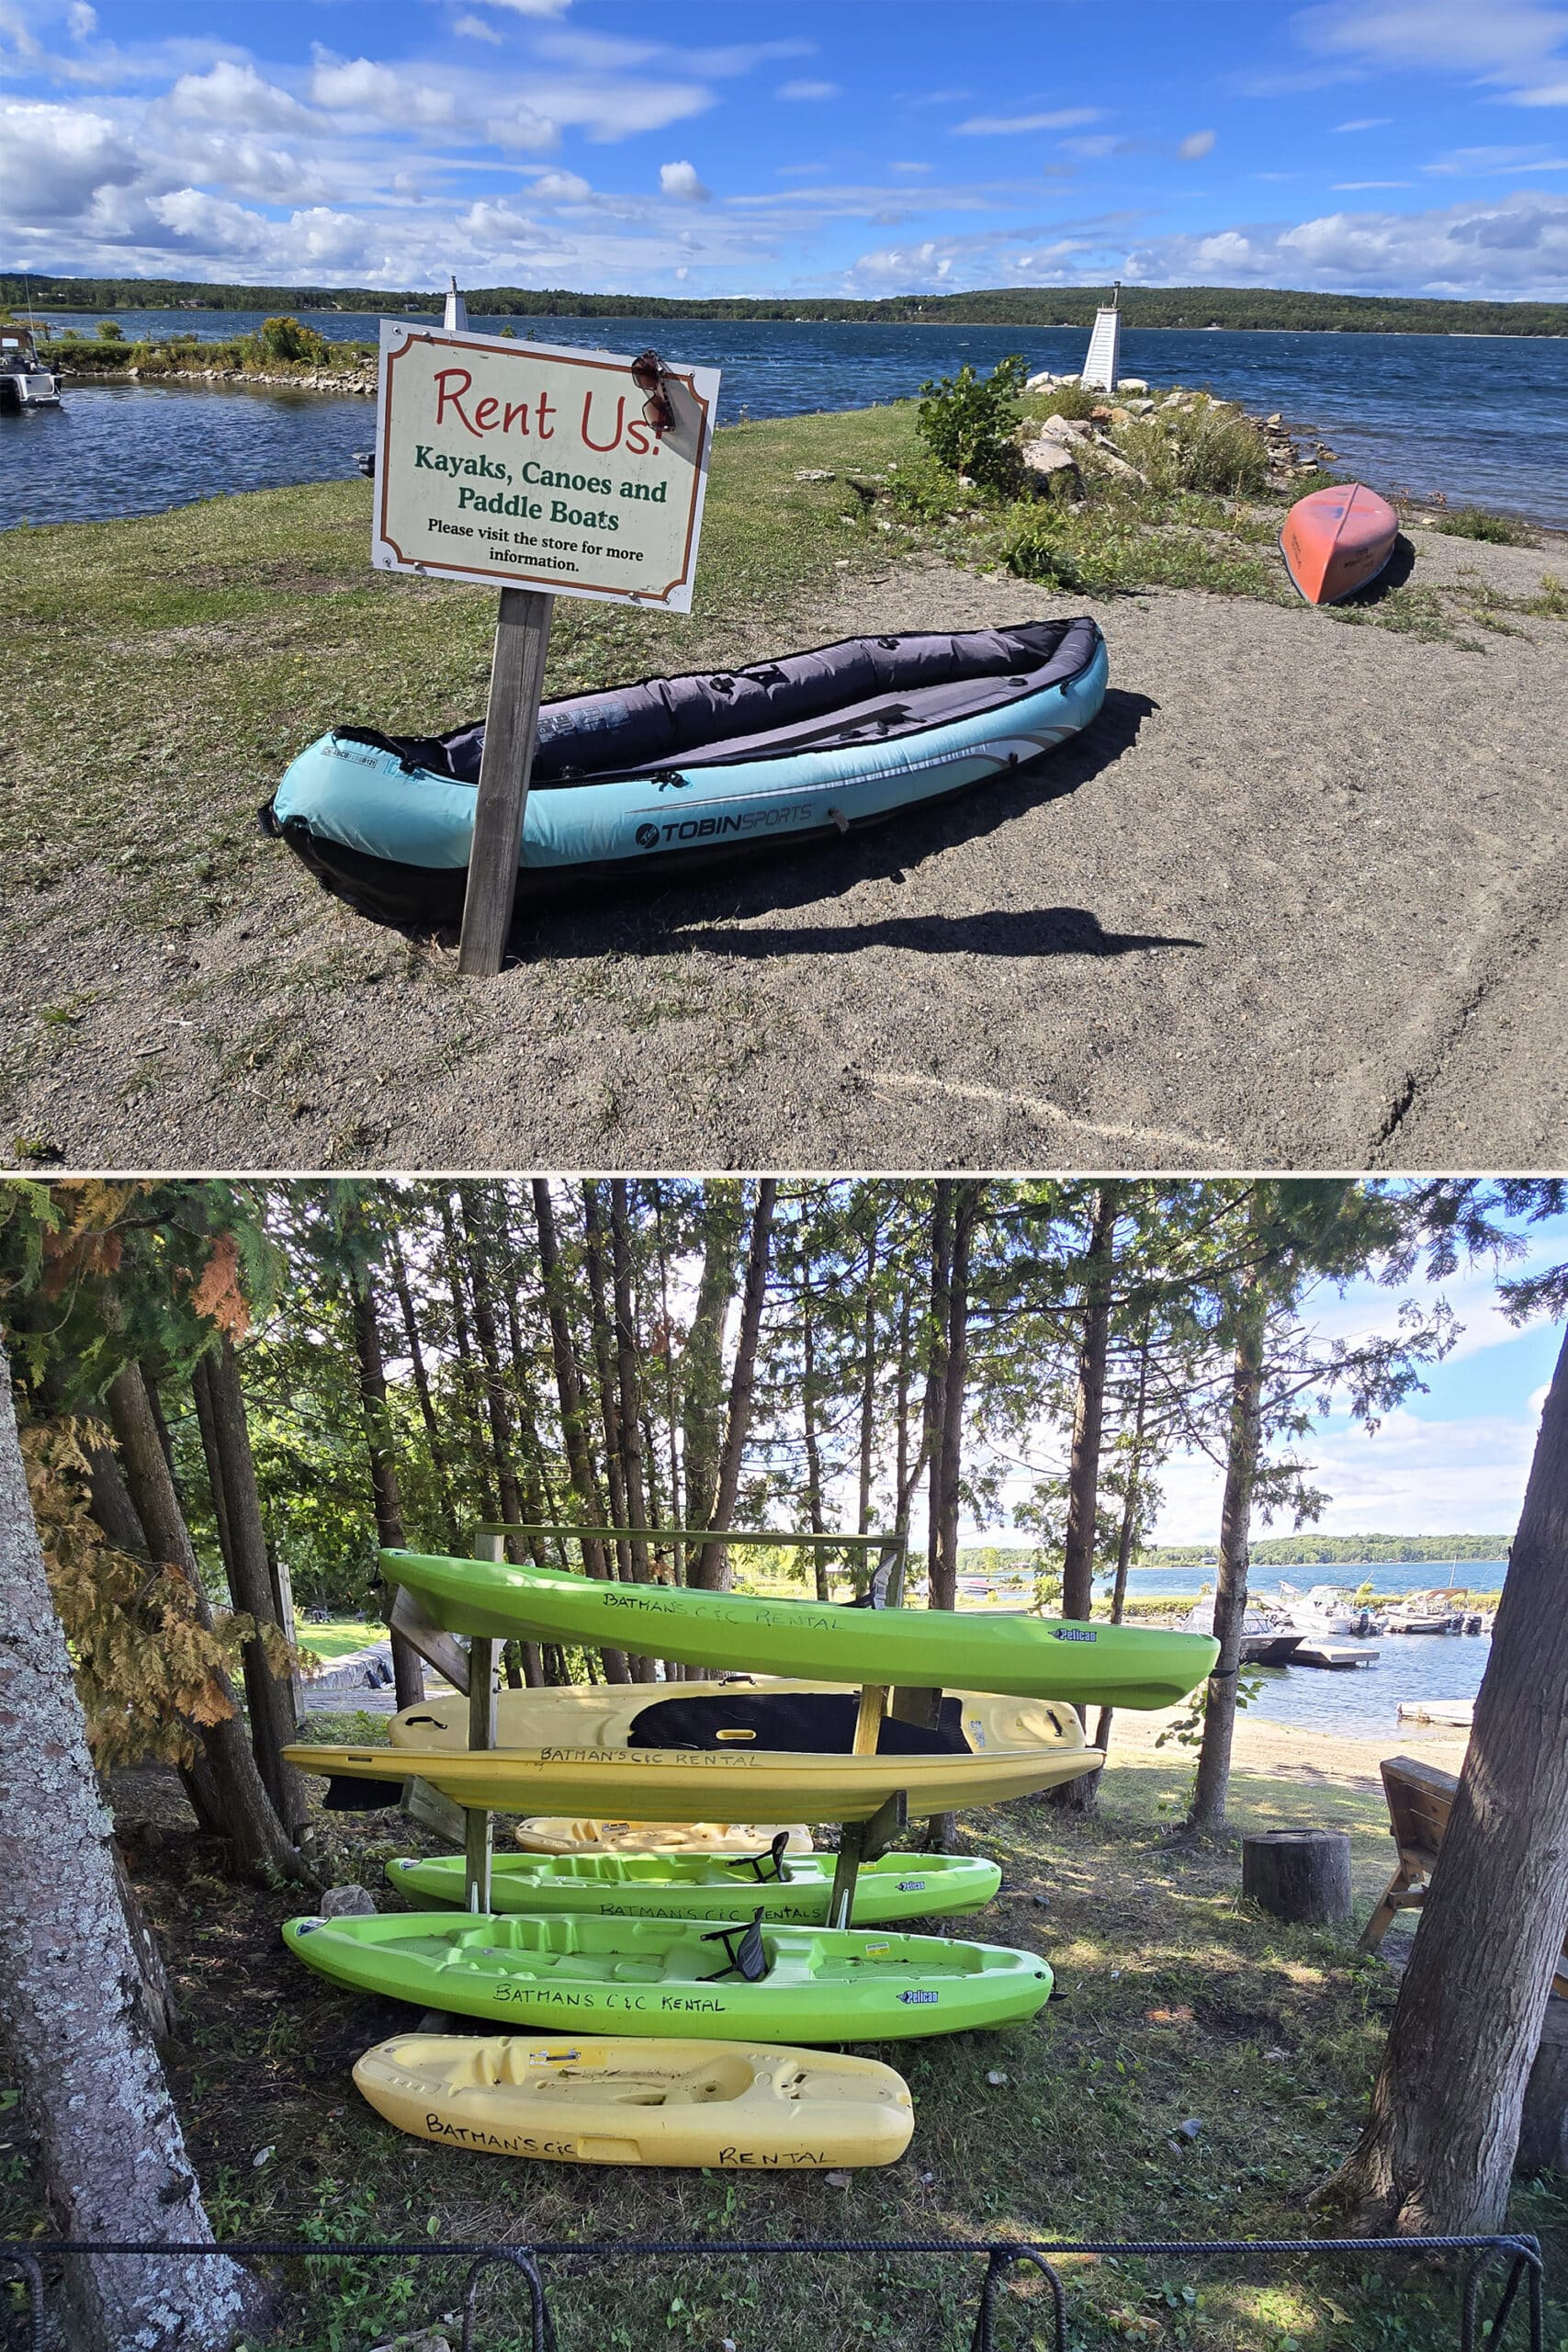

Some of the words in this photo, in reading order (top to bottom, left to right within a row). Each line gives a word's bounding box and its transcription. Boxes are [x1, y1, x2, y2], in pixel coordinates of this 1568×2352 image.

[433, 368, 557, 439] Rent
[414, 445, 513, 486] Kayaks,
[522, 461, 612, 495] Canoes
[619, 481, 668, 503] and
[457, 486, 542, 520] Paddle
[549, 501, 619, 531] Boats
[427, 518, 474, 537] Please
[478, 526, 509, 543] visit
[513, 530, 537, 547] the
[541, 537, 578, 553] store
[581, 540, 603, 557] for
[605, 546, 644, 562] more
[489, 547, 580, 572] information.
[755, 1610, 845, 1631] RENTAL
[1056, 1627, 1097, 1642] Pelican
[540, 1747, 627, 1762] BATMAN'S
[676, 1754, 764, 1767] RENTAL
[661, 1996, 728, 2012] RENTAL
[905, 1990, 939, 2004] Pelican
[425, 2113, 538, 2152] BATMAN'S
[718, 2146, 837, 2165] RENTAL
